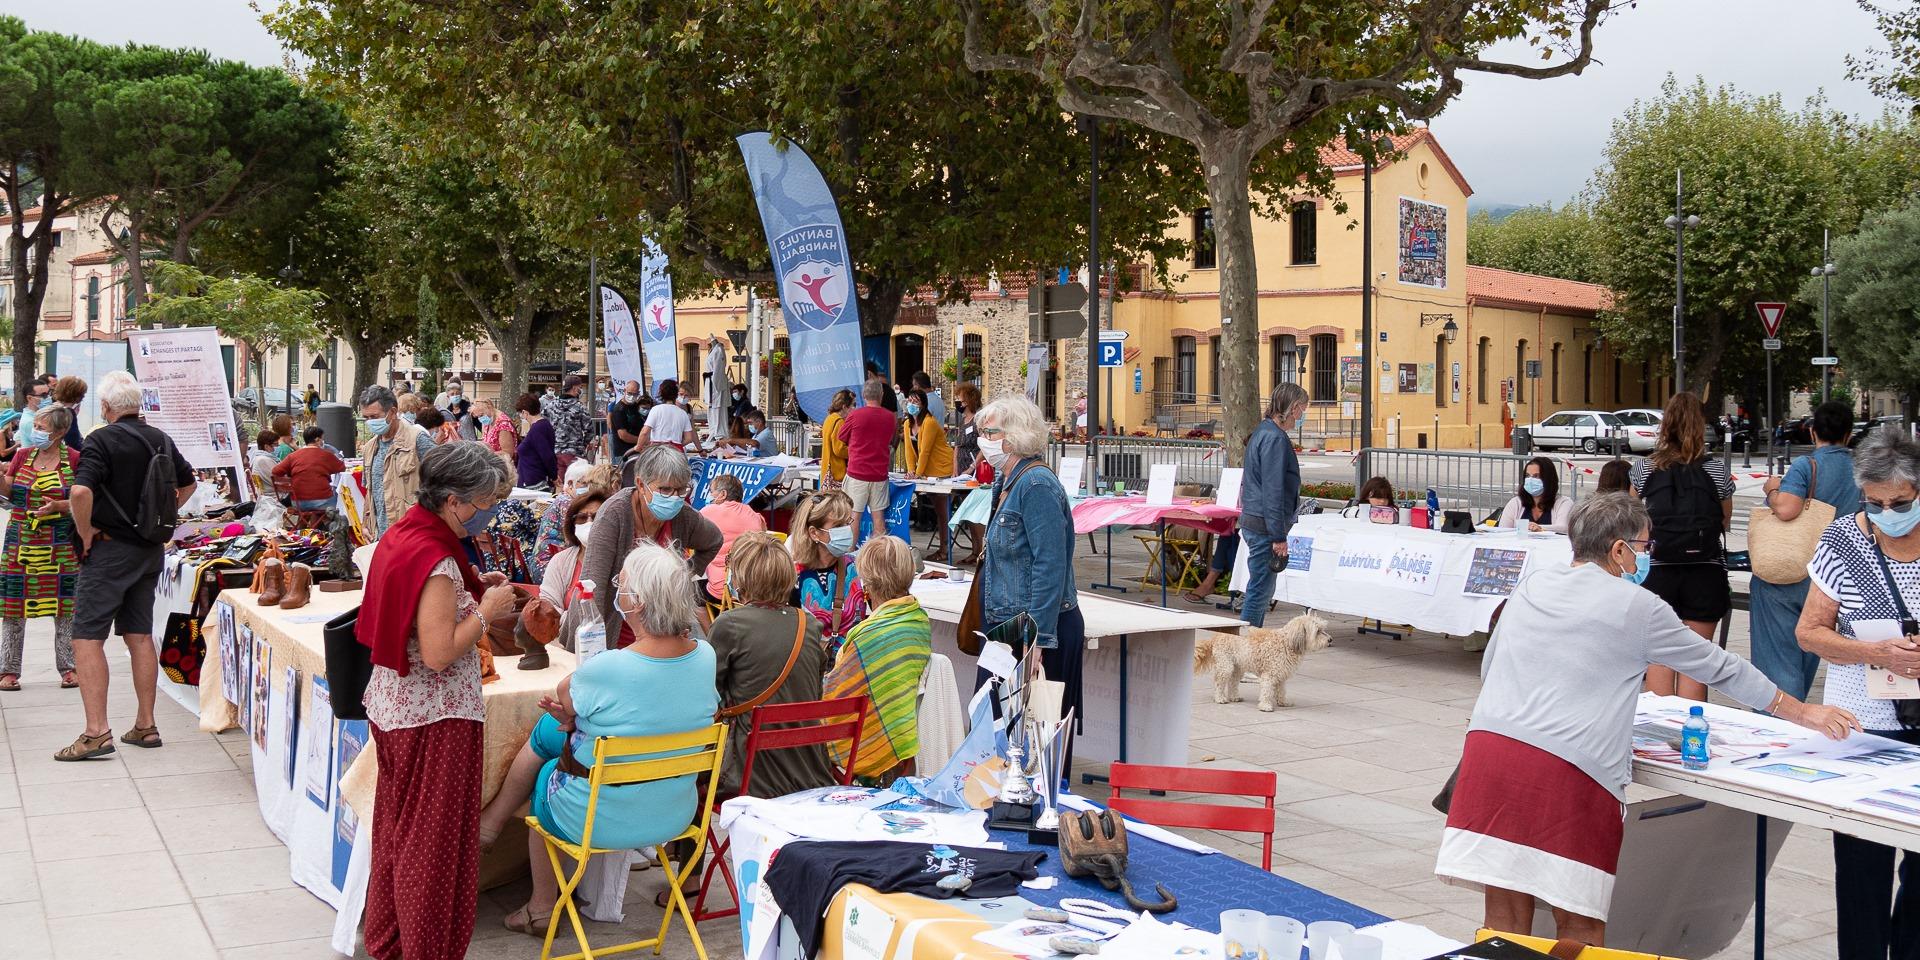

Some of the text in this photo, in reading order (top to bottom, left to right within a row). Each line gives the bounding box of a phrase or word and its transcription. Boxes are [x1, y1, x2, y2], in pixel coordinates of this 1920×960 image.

[1104, 345, 1116, 362] P
[707, 462, 765, 486] BANYULS
[1338, 555, 1433, 575] BANYULS DANSE
